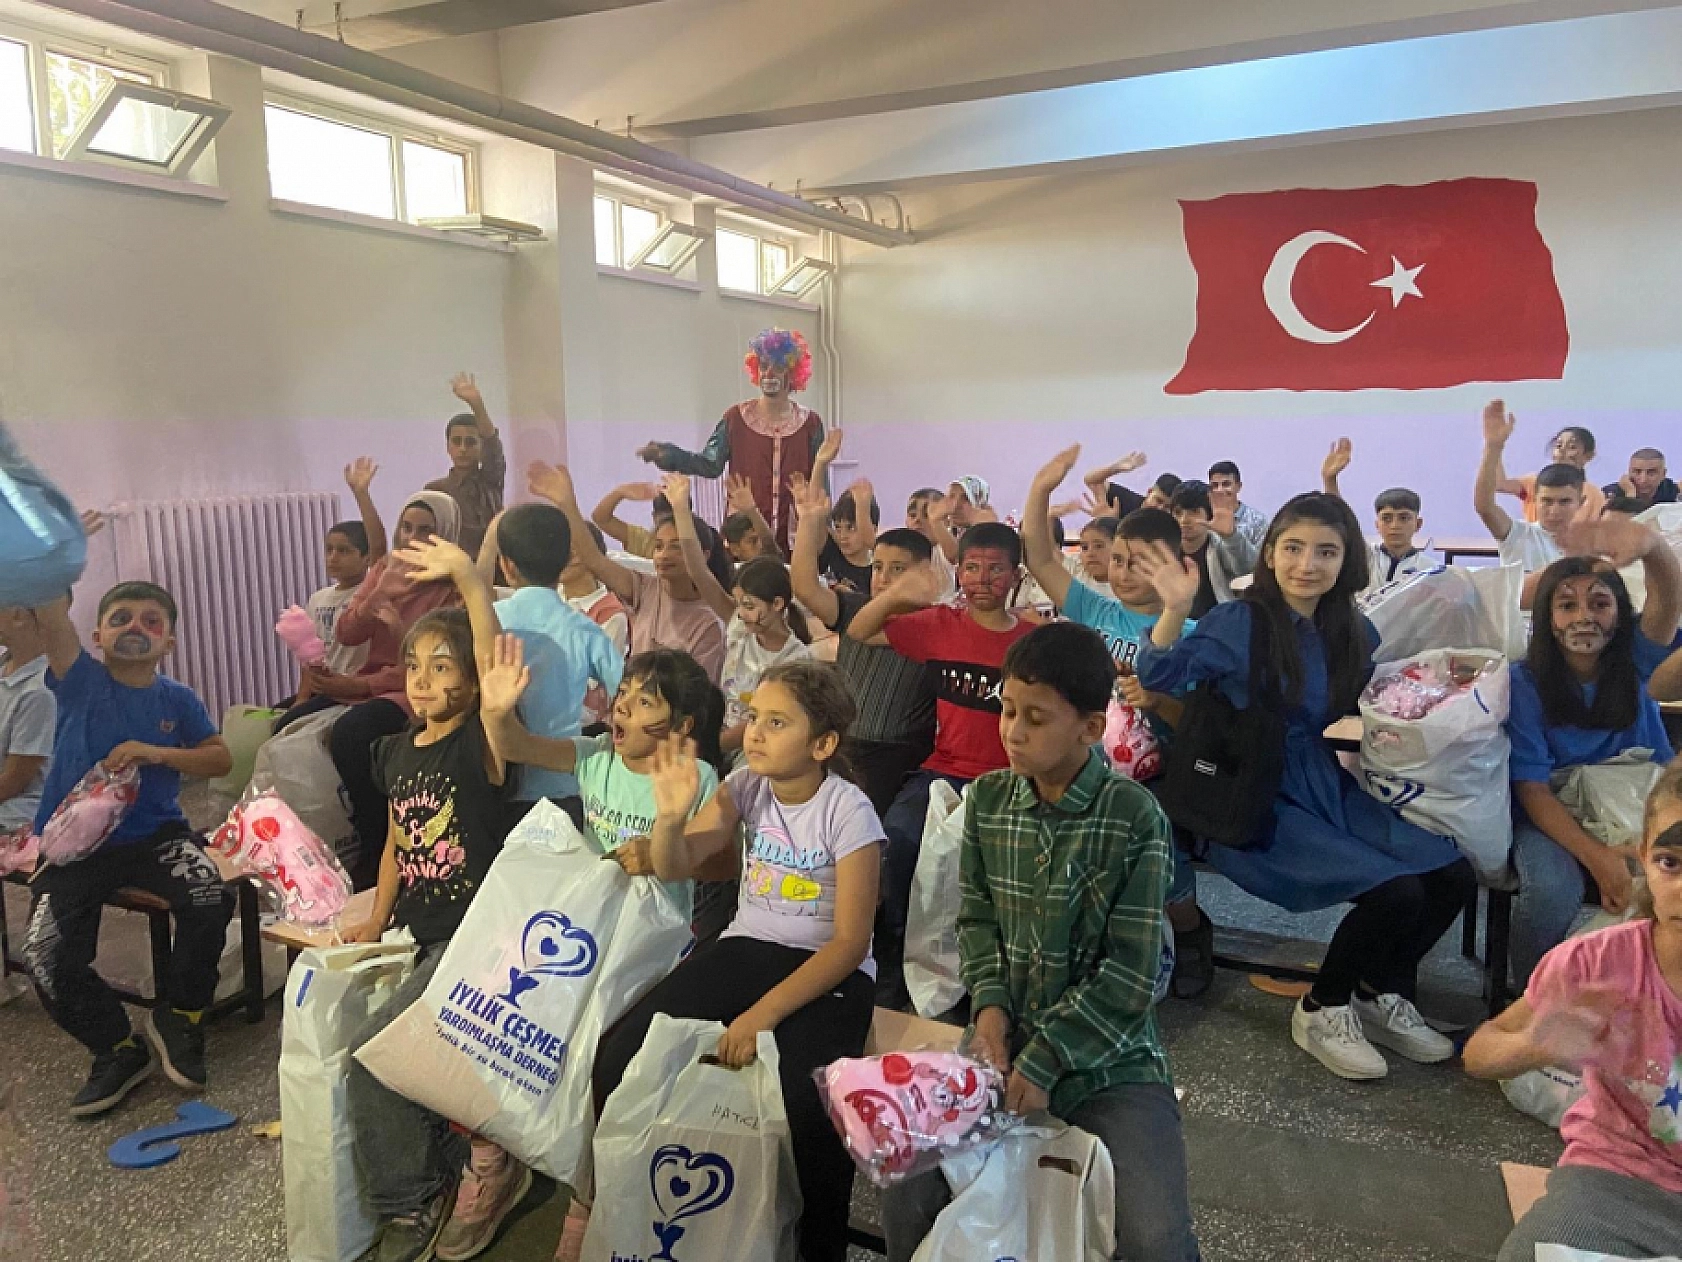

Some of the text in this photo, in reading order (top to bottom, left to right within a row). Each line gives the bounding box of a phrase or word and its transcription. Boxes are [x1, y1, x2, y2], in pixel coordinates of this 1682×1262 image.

[438, 1006, 559, 1086] YARDIMLAŞMA DERNEĞ
[448, 977, 567, 1064] İYİLİK ÇEŞMES
